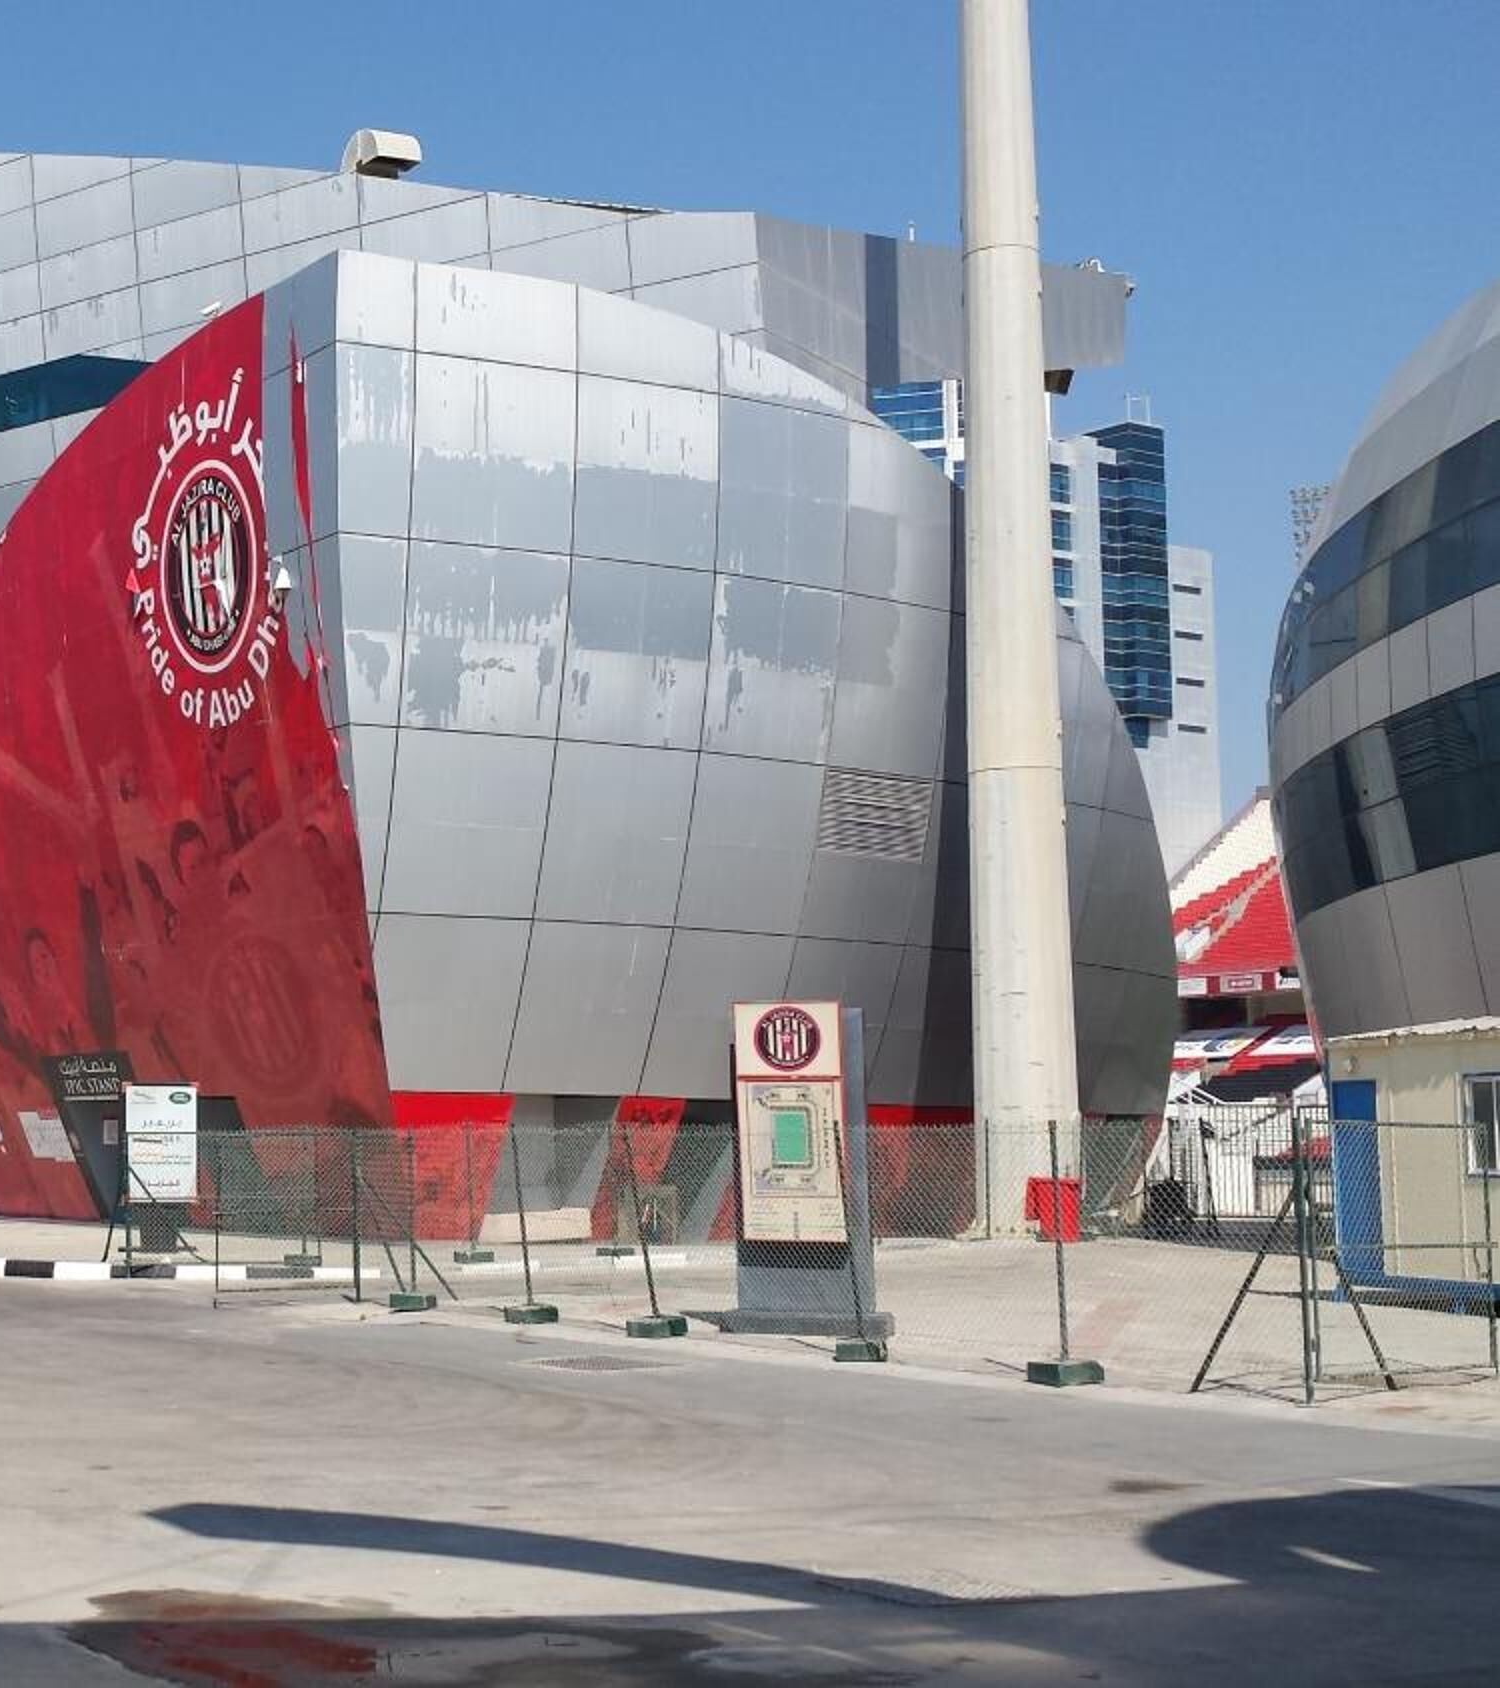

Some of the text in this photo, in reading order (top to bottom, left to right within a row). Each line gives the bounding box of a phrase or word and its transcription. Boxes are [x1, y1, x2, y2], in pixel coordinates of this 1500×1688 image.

[216, 481, 241, 523] CLUB
[134, 588, 176, 695] Pride
[180, 687, 205, 725] of
[209, 679, 255, 729] Abu
